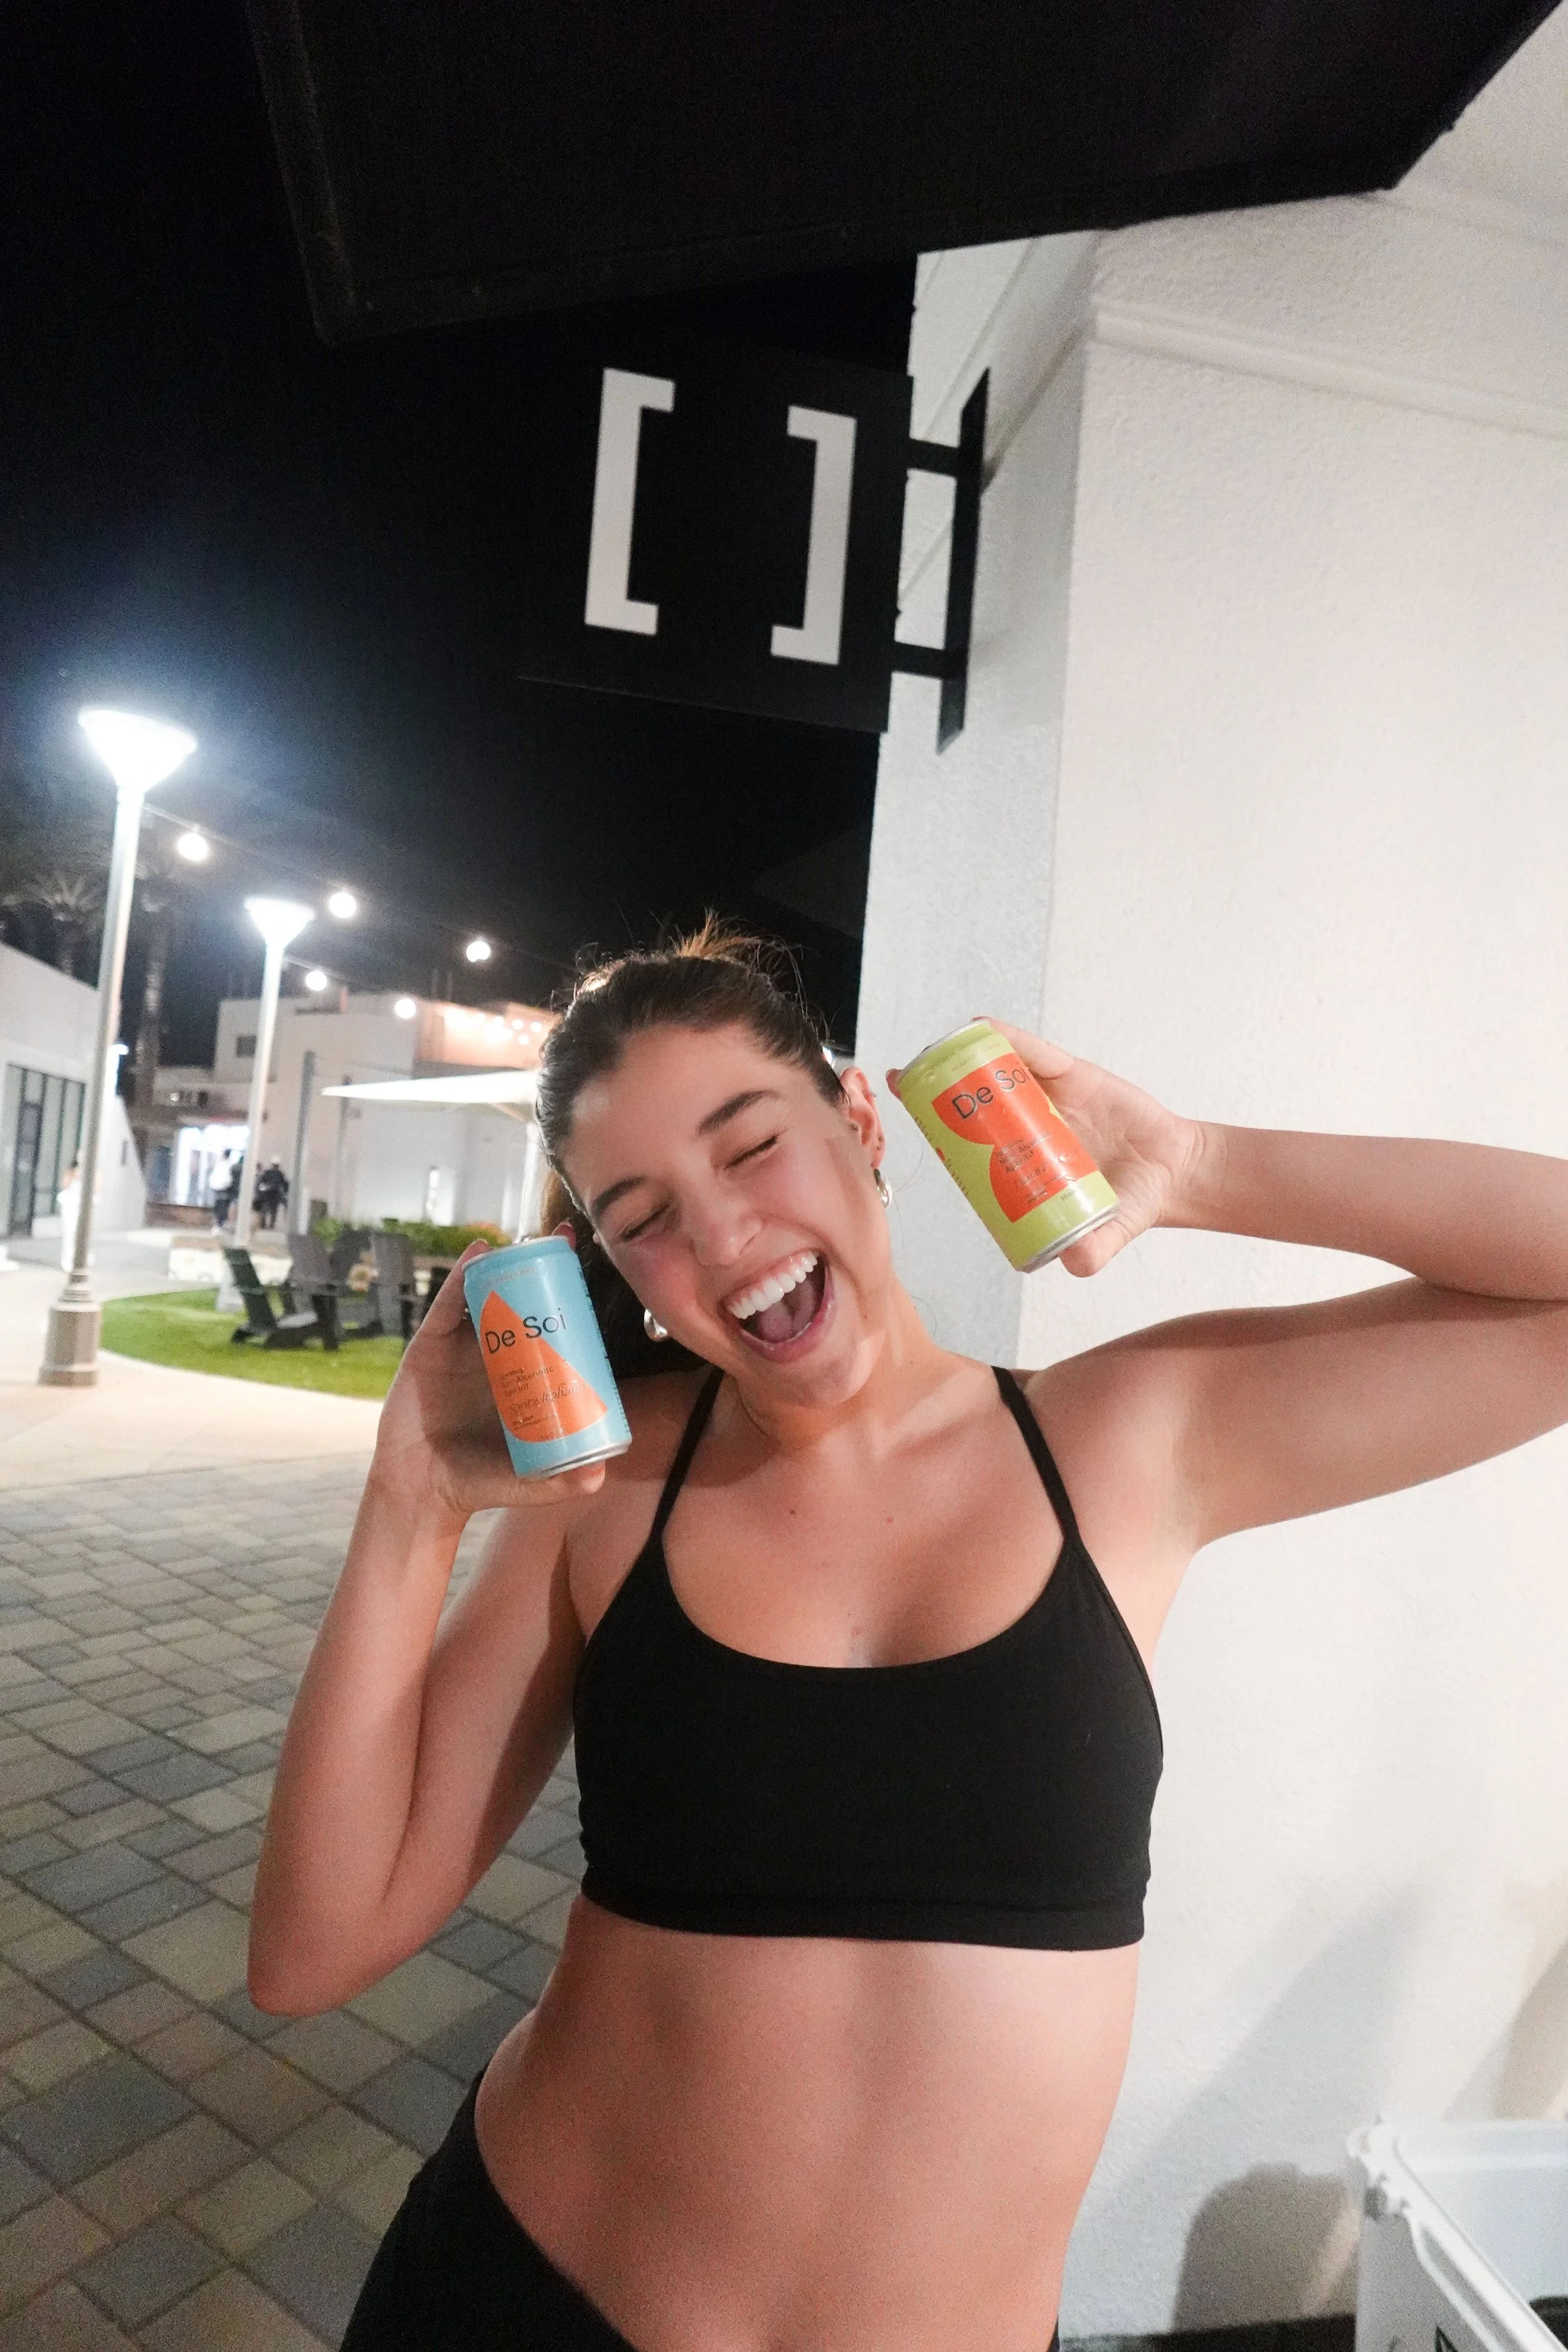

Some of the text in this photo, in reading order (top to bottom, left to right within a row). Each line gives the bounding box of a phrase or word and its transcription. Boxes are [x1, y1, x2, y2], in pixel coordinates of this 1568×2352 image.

[952, 1061, 1029, 1119] De Soi
[485, 1307, 566, 1354] De Soi
